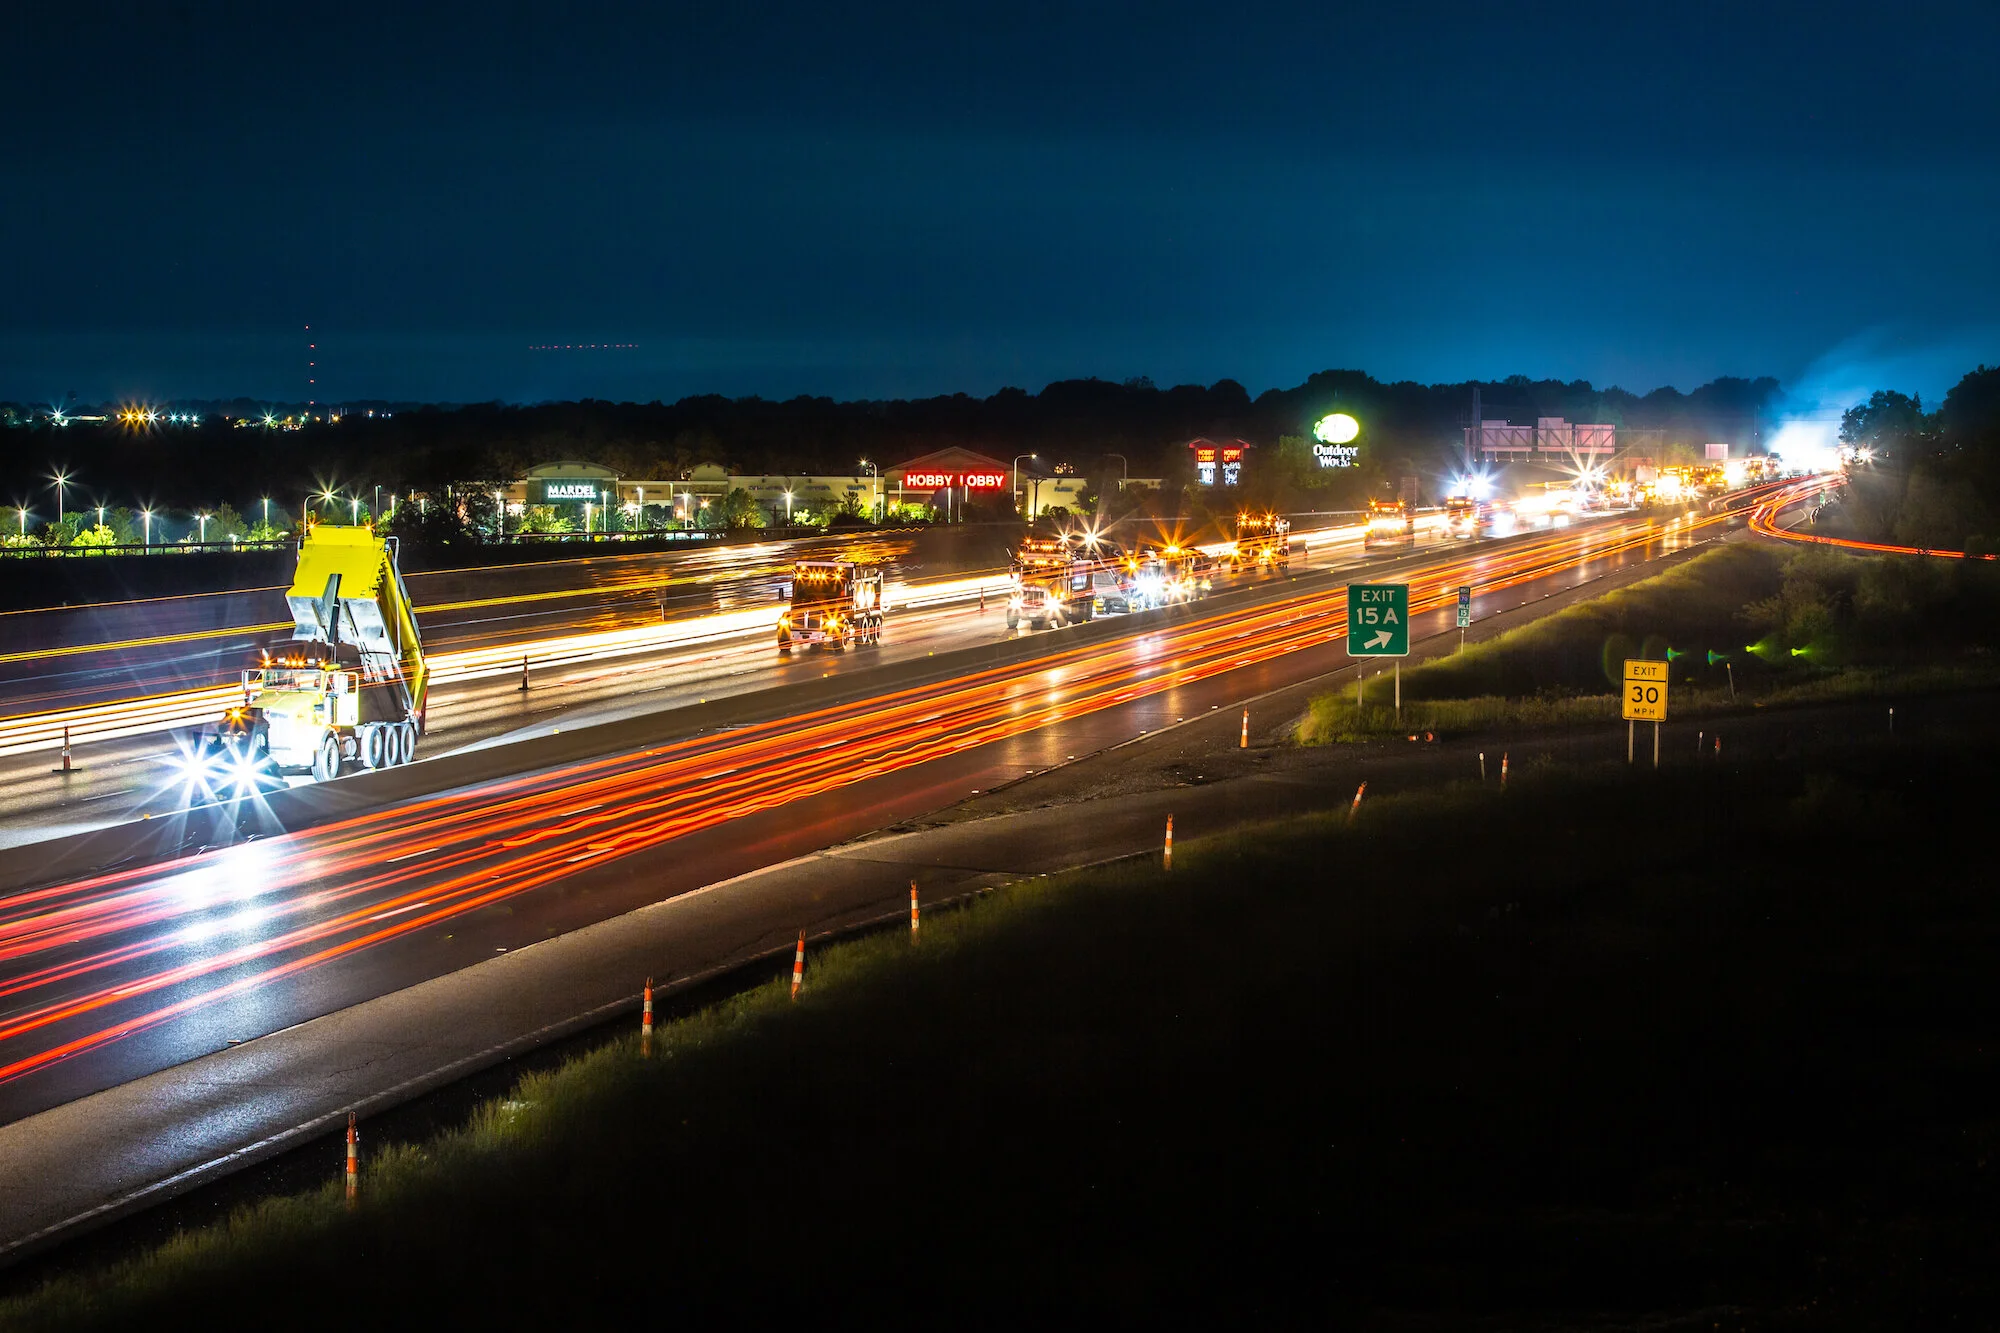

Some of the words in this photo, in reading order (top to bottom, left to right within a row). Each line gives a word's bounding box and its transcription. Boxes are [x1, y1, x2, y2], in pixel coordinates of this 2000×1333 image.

[1313, 444, 1358, 456] Outdoor
[907, 474, 953, 486] HOBBY
[548, 485, 596, 496] MARDEL
[1361, 590, 1395, 602] EXIT
[1633, 666, 1657, 676] EXIT
[1631, 686, 1659, 703] 30
[1633, 708, 1655, 716] MPH
